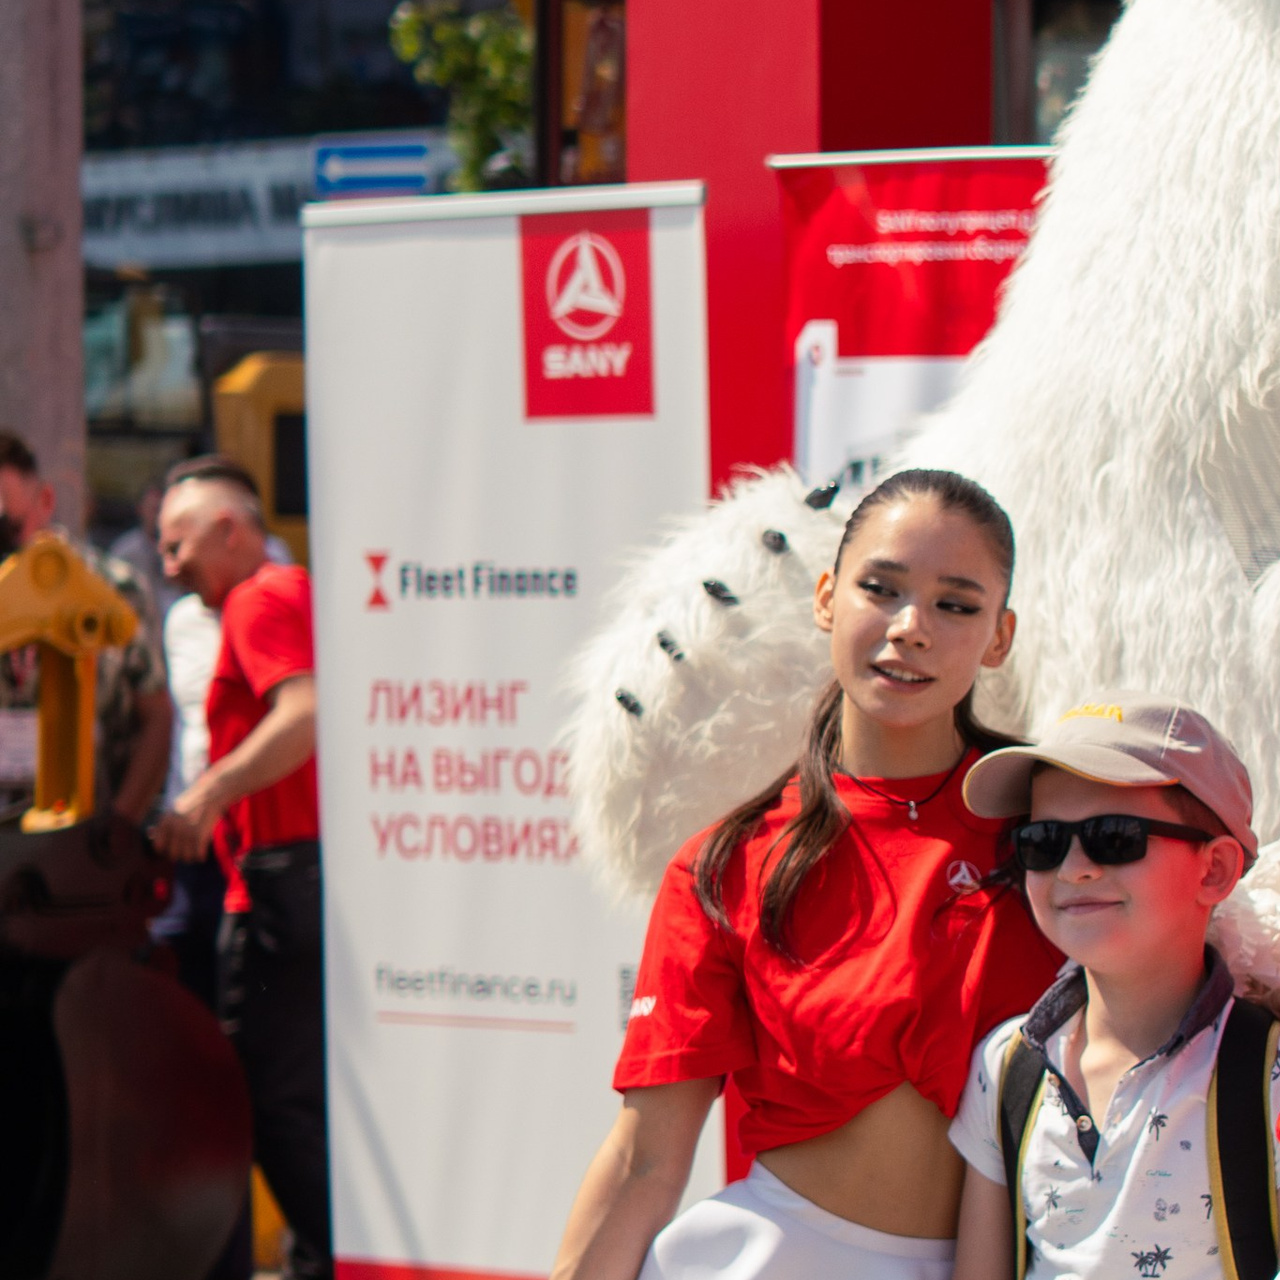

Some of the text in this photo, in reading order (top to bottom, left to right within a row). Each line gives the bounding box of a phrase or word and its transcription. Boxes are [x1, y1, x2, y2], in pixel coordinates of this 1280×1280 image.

[543, 341, 632, 380] SANY
[400, 561, 577, 600] Fleet Finance
[367, 677, 528, 725] ЛИЗИНГ
[369, 747, 424, 793] НА
[376, 962, 577, 1007] fleetfinance.ru
